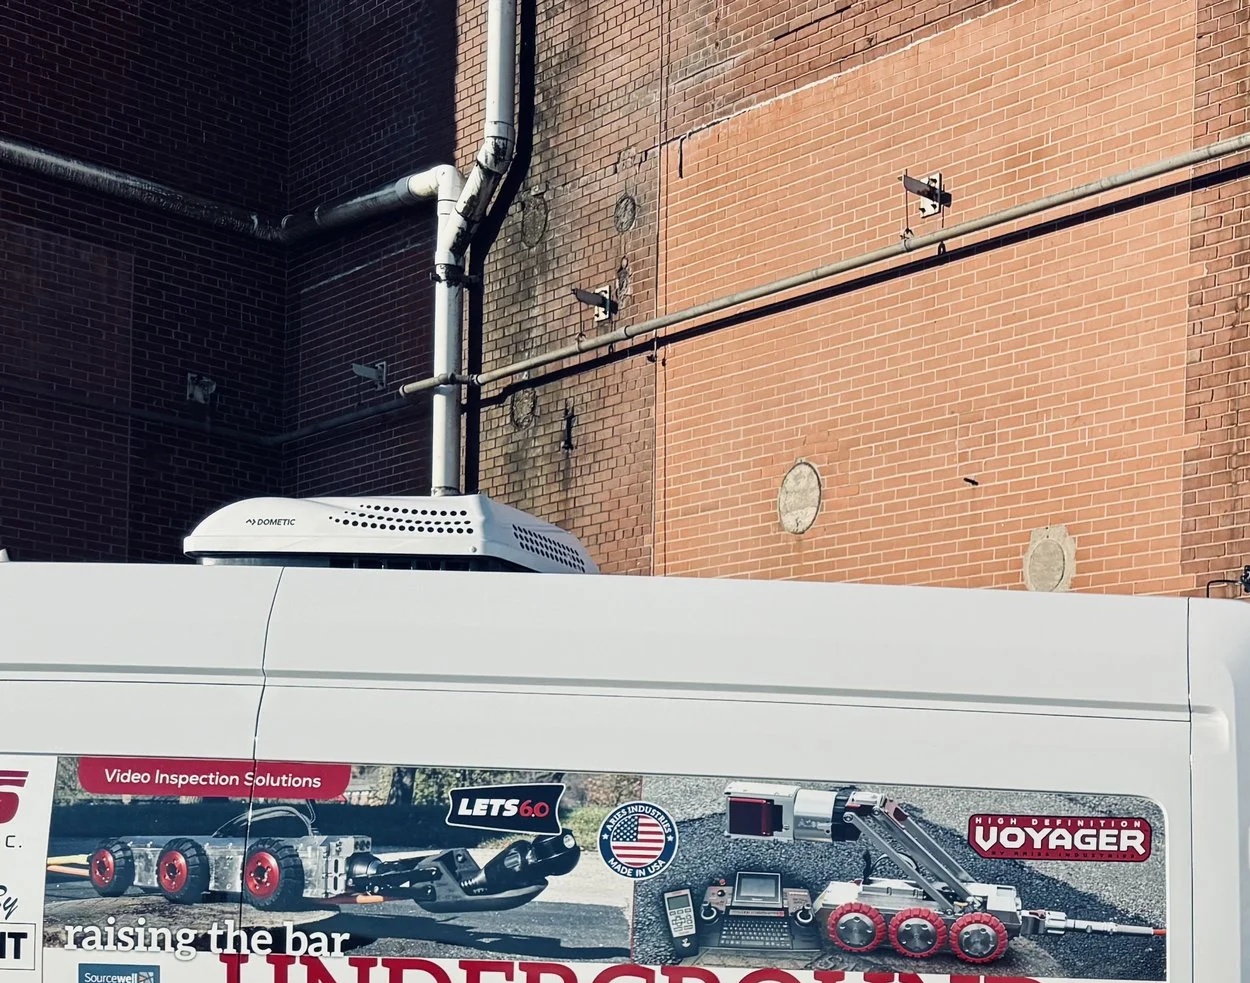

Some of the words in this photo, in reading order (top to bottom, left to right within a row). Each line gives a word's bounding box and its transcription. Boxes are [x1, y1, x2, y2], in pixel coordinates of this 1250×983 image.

[257, 518, 296, 526] DOMETIC
[104, 768, 151, 784] Video
[154, 770, 240, 788] Inspection
[243, 772, 322, 788] Solutions
[606, 808, 628, 832] ARIES
[627, 805, 673, 834] INDUSTRIES
[975, 817, 1018, 826] HIGH
[1031, 818, 1142, 828] DEFINITION
[974, 825, 1146, 856] VOYAGER
[608, 857, 634, 877] MADE
[635, 868, 646, 878] IN
[647, 859, 666, 874] USA
[64, 916, 198, 961] raising
[207, 919, 273, 956] the
[284, 921, 350, 957] bar
[84, 972, 138, 983] Sourcewell
